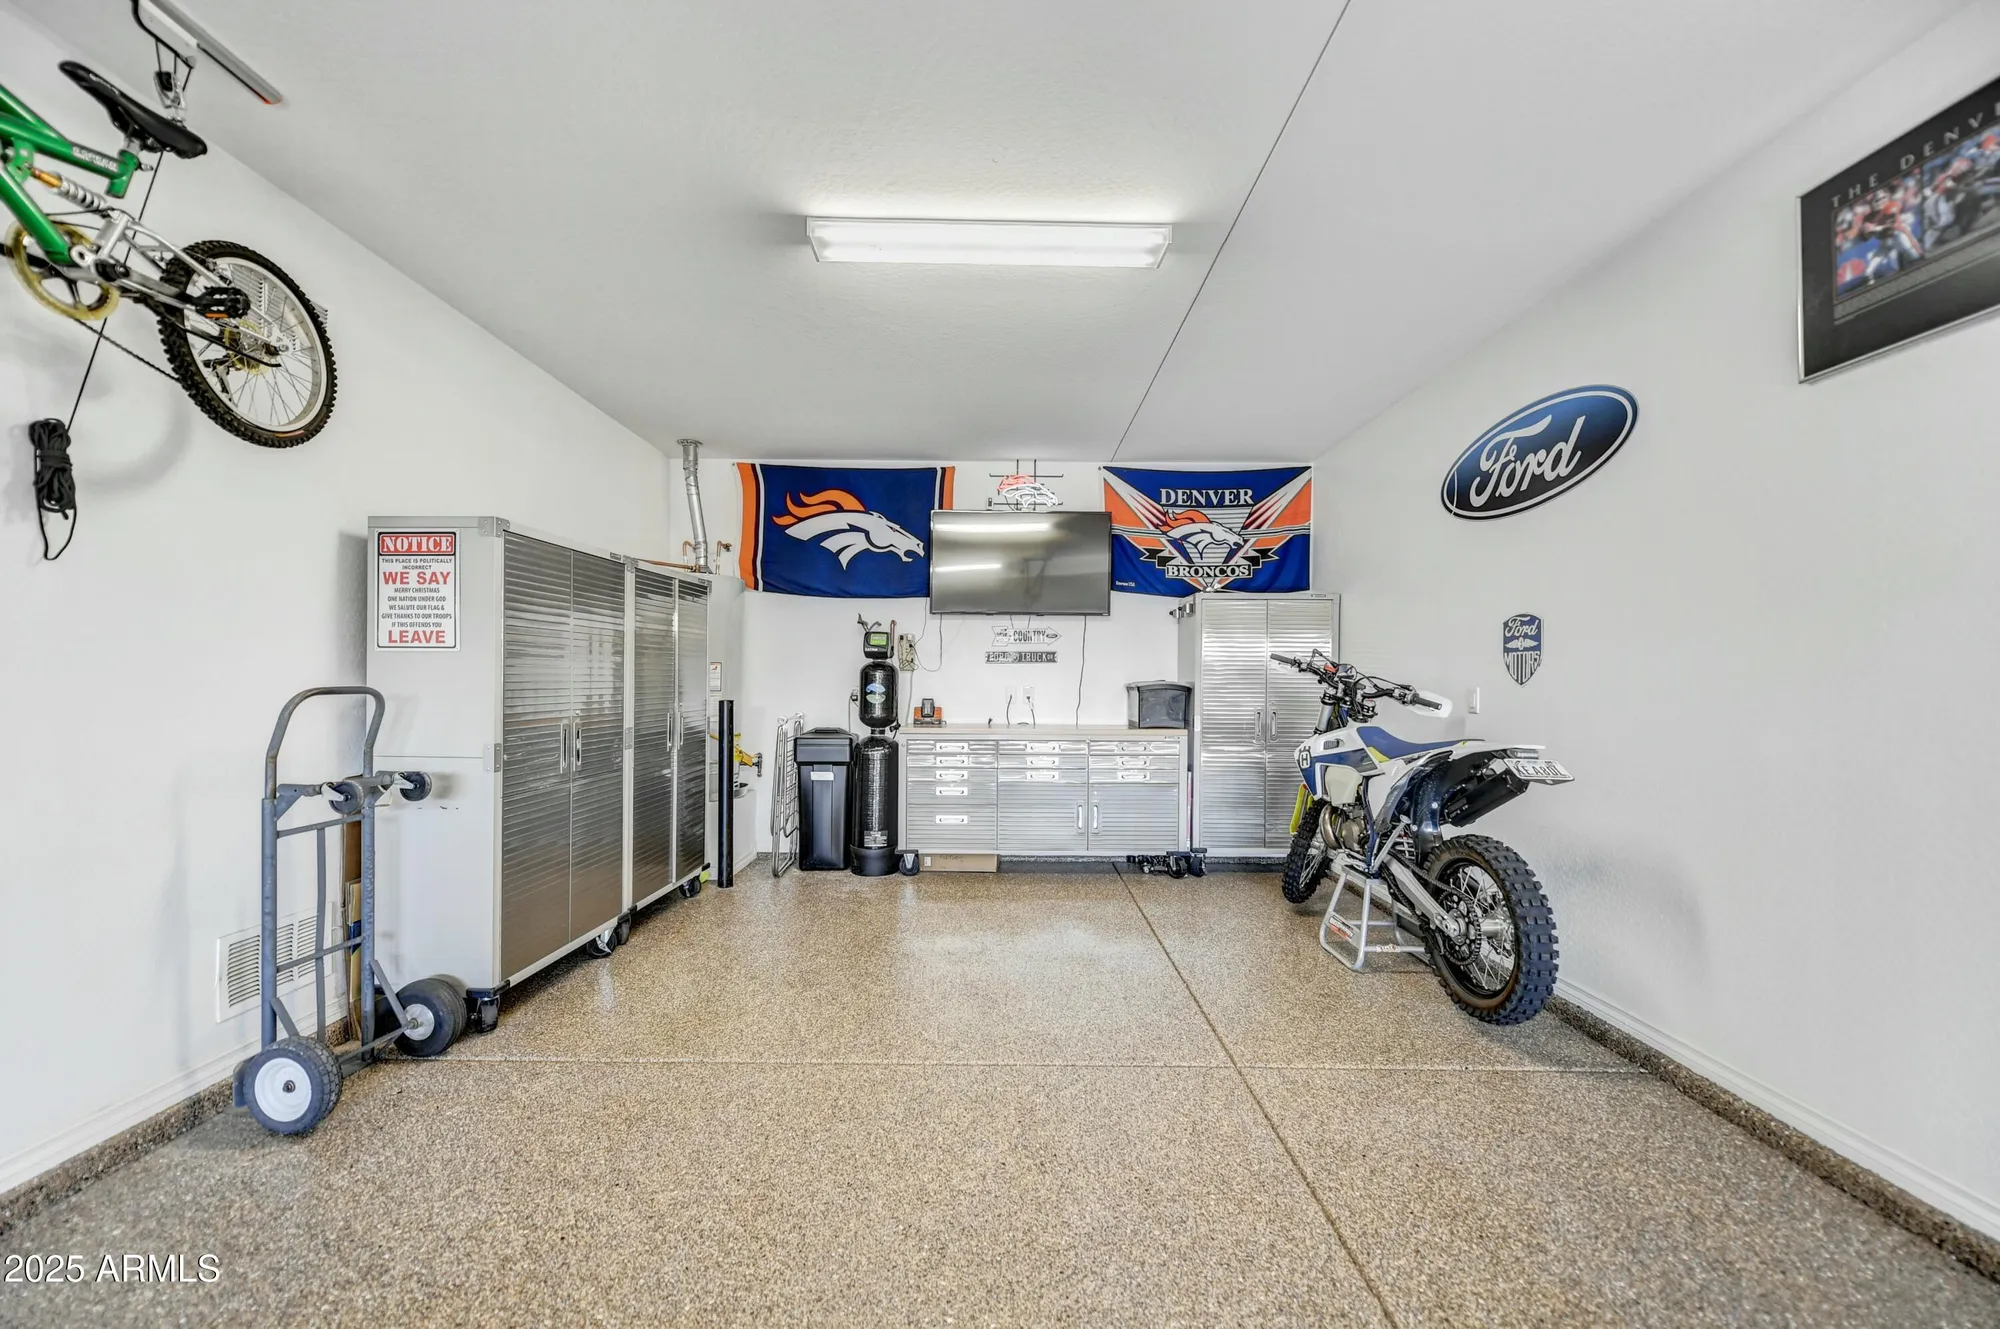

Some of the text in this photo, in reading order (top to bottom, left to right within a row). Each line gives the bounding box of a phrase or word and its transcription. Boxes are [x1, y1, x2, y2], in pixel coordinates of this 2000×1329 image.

[1832, 174, 1878, 207] THE
[1469, 414, 1586, 508] Ford
[1160, 488, 1254, 506] DENVER
[382, 536, 452, 552] NOTICE
[383, 571, 451, 585] WE SAY
[1167, 565, 1249, 578] BRONCOS
[1504, 616, 1539, 637] Ford
[388, 630, 446, 644] LEAVE
[1013, 630, 1046, 642] COUNTRY
[1020, 652, 1047, 661] TRUCK
[1504, 651, 1541, 683] MOTORS
